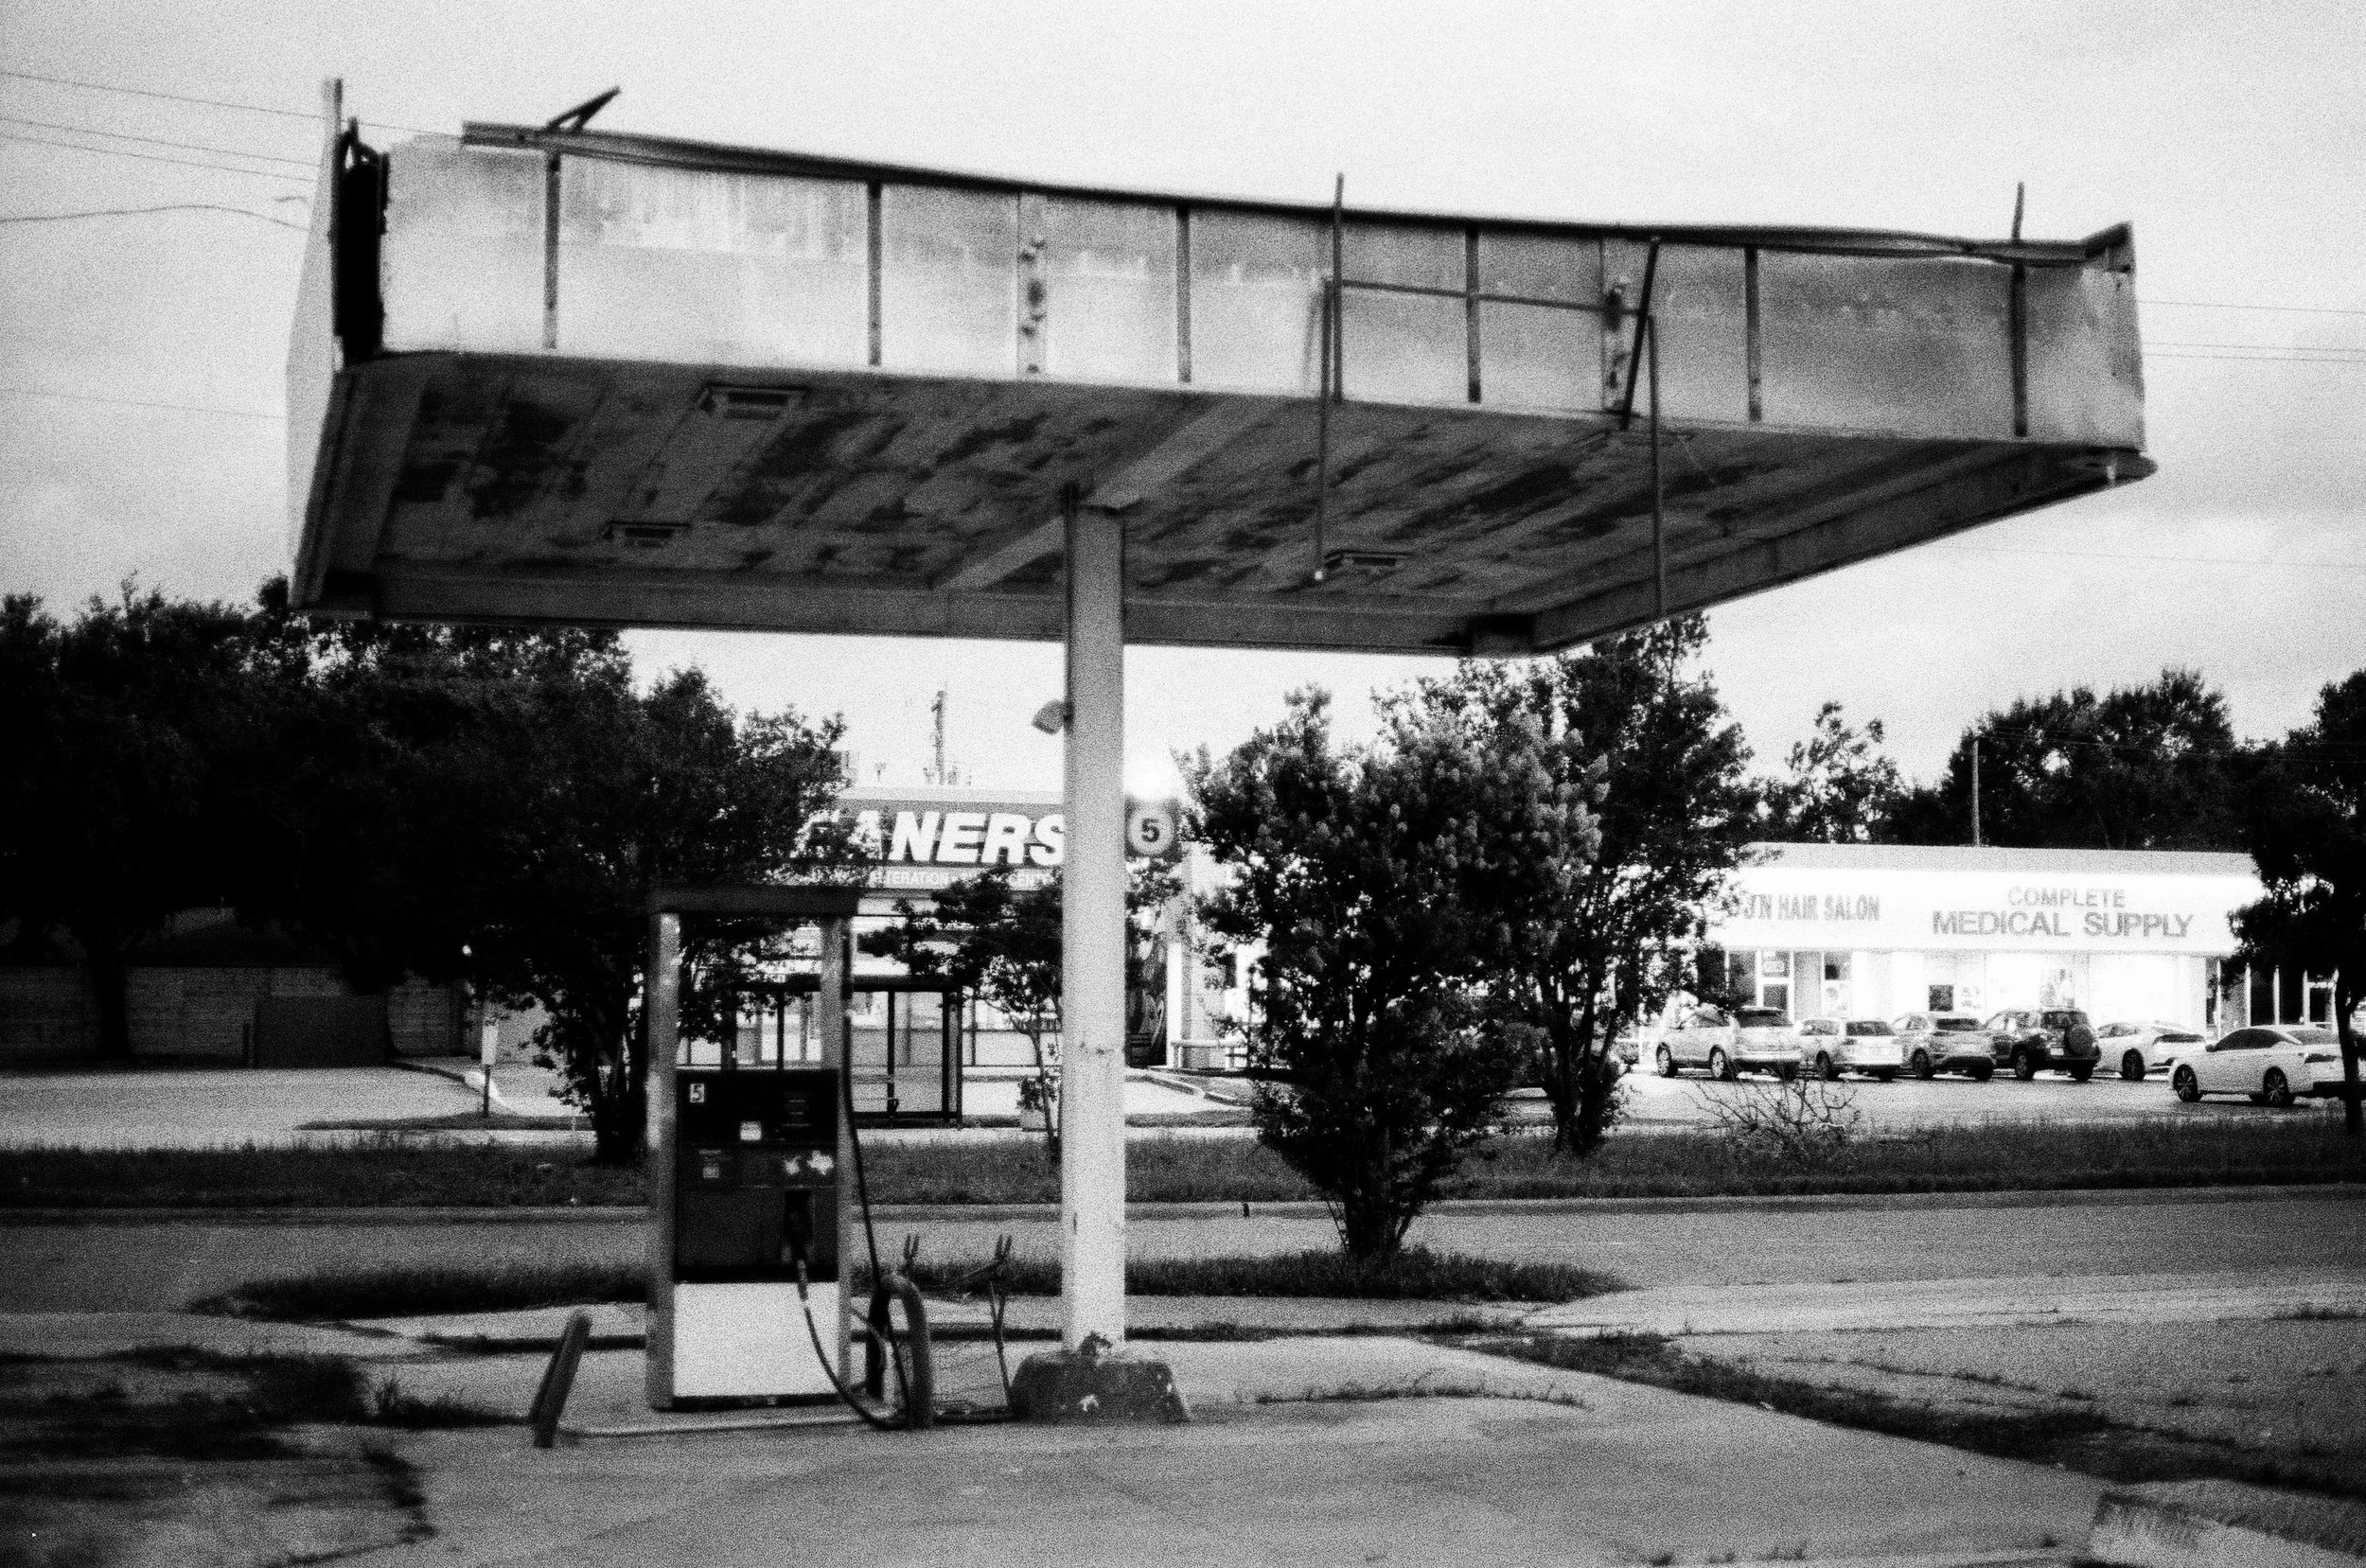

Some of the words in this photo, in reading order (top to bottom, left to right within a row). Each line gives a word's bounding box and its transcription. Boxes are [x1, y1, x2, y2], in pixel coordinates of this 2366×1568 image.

[1141, 818, 1160, 843] 5
[1776, 893, 1817, 921] HAIR
[1823, 893, 1880, 922] SALON
[2007, 886, 2127, 908] COMPLETE
[1932, 910, 2071, 937] MEDICAL
[2083, 911, 2195, 939] SUPPLY
